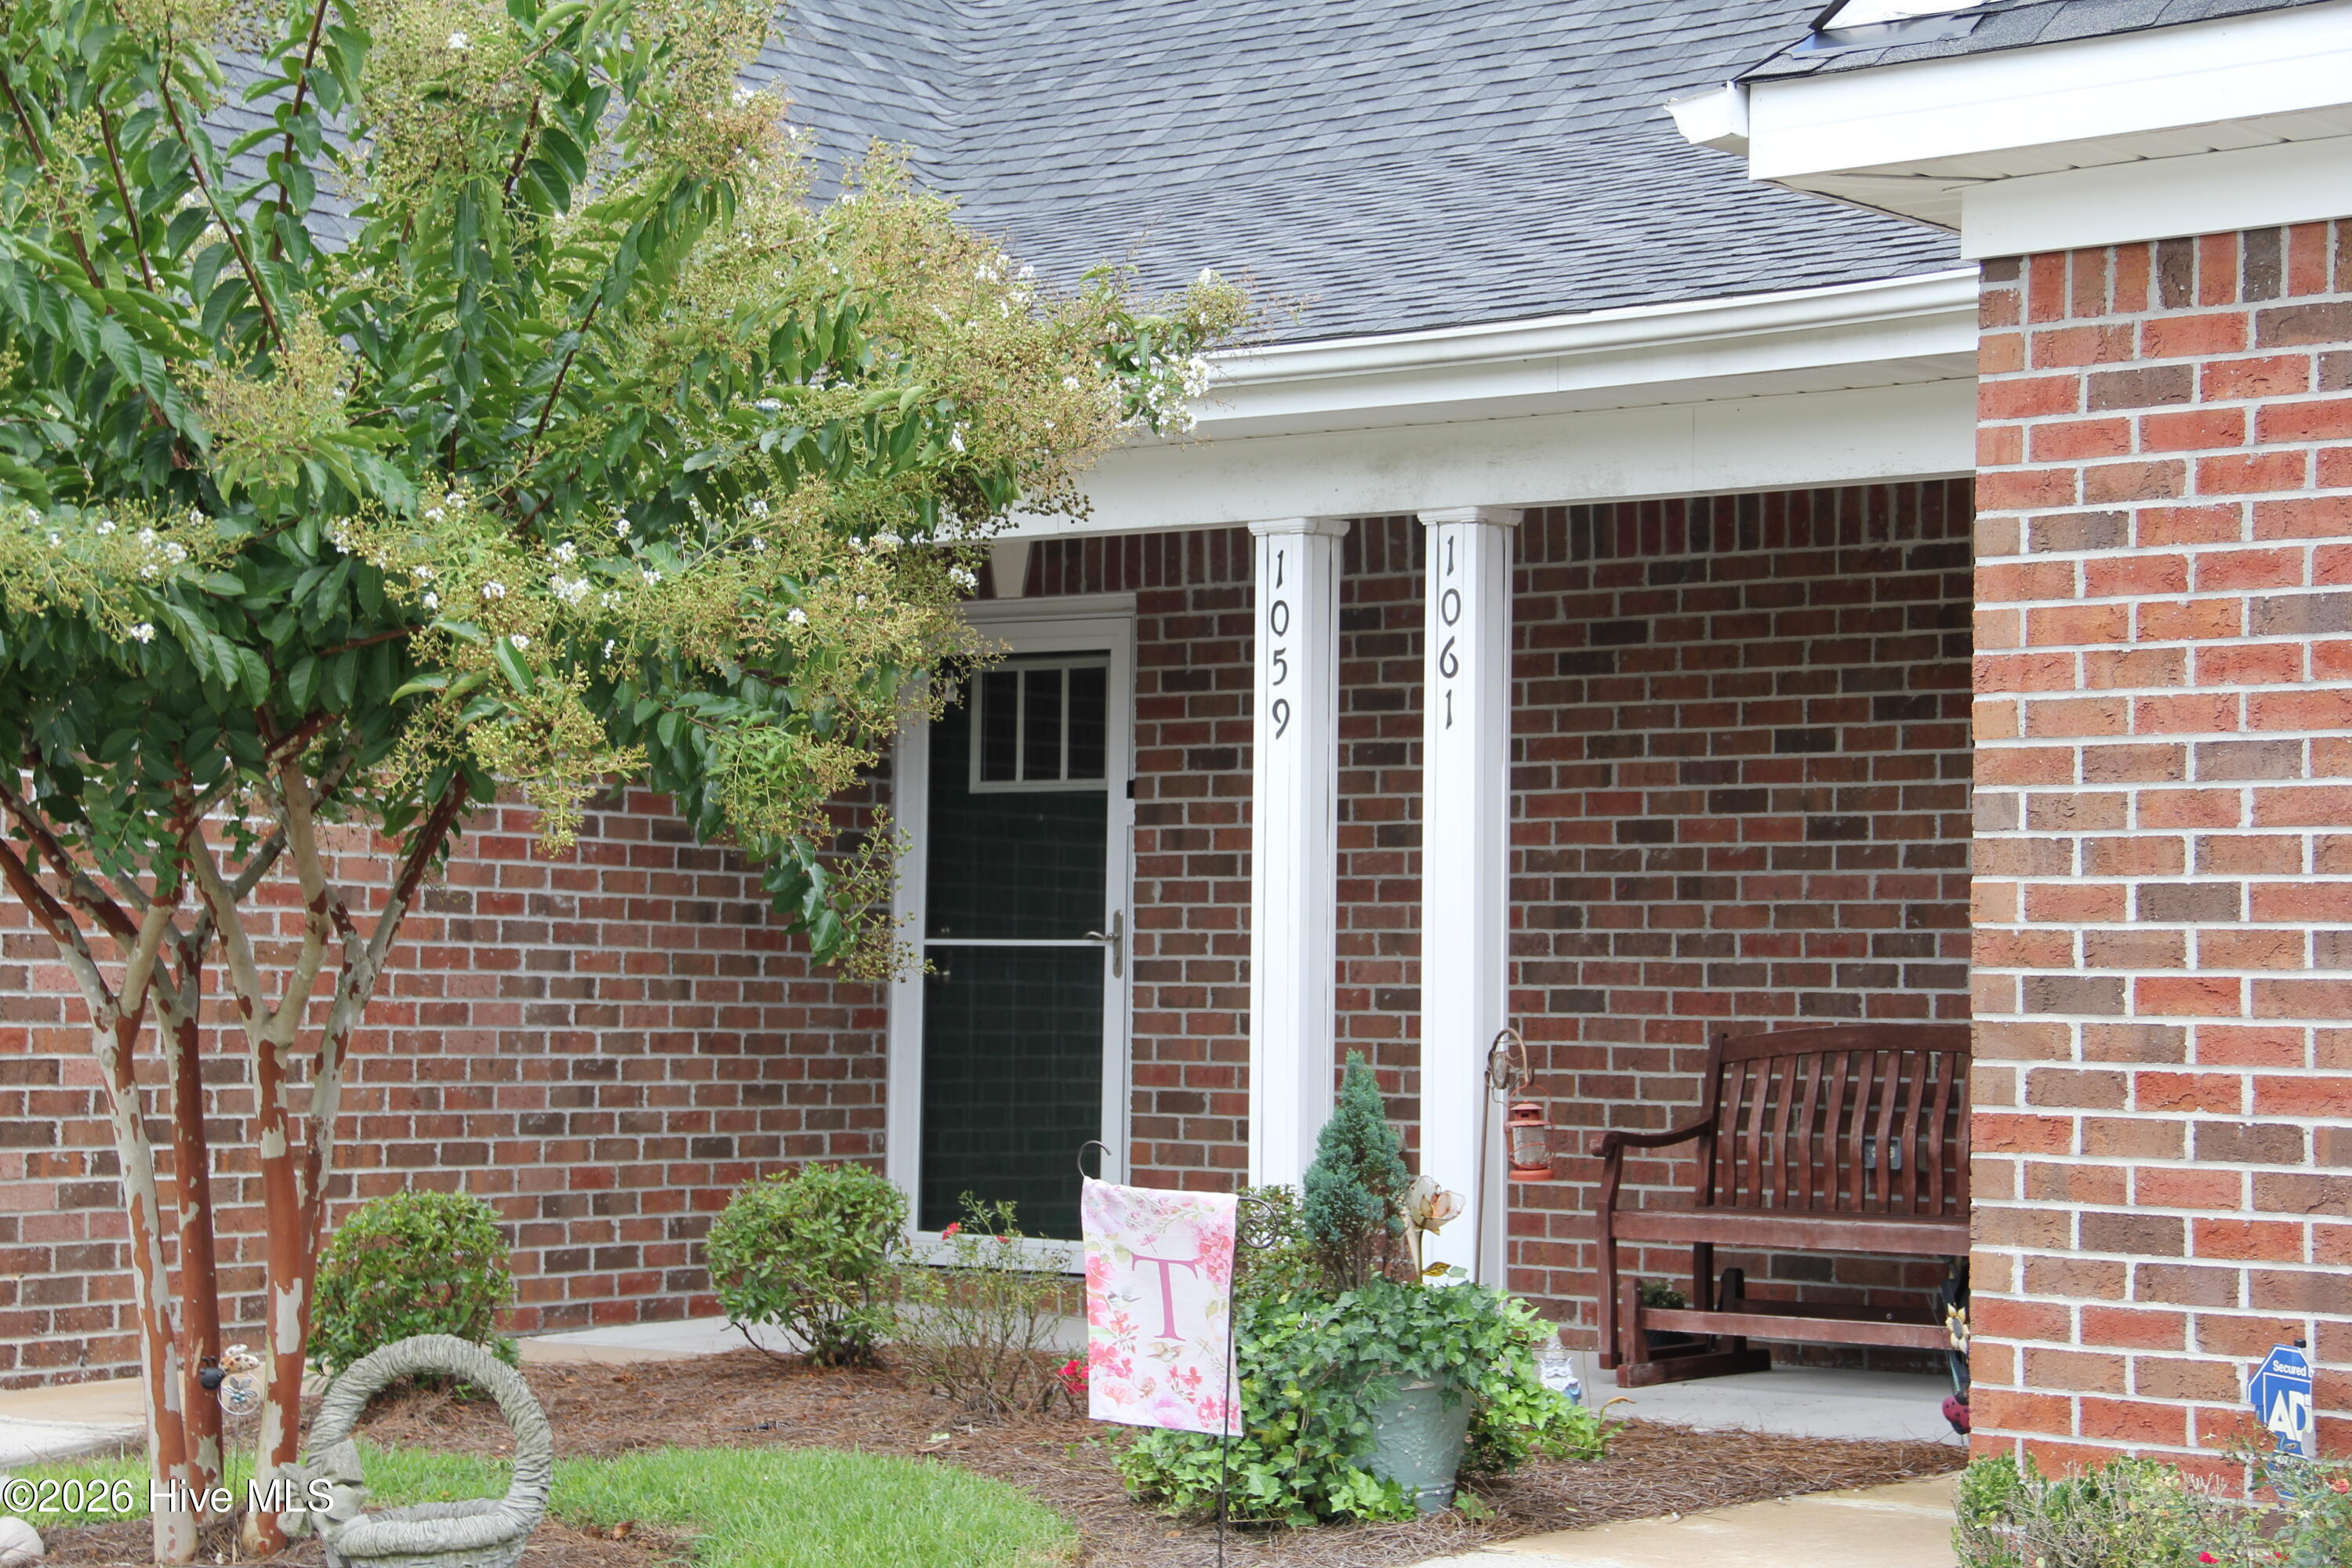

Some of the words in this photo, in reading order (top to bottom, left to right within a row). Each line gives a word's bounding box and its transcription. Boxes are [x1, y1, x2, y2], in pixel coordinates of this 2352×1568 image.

[1270, 549, 1290, 740] 1059
[1439, 535, 1461, 731] 1061
[1131, 1252, 1199, 1342] T
[2272, 1359, 2307, 1377] Secured
